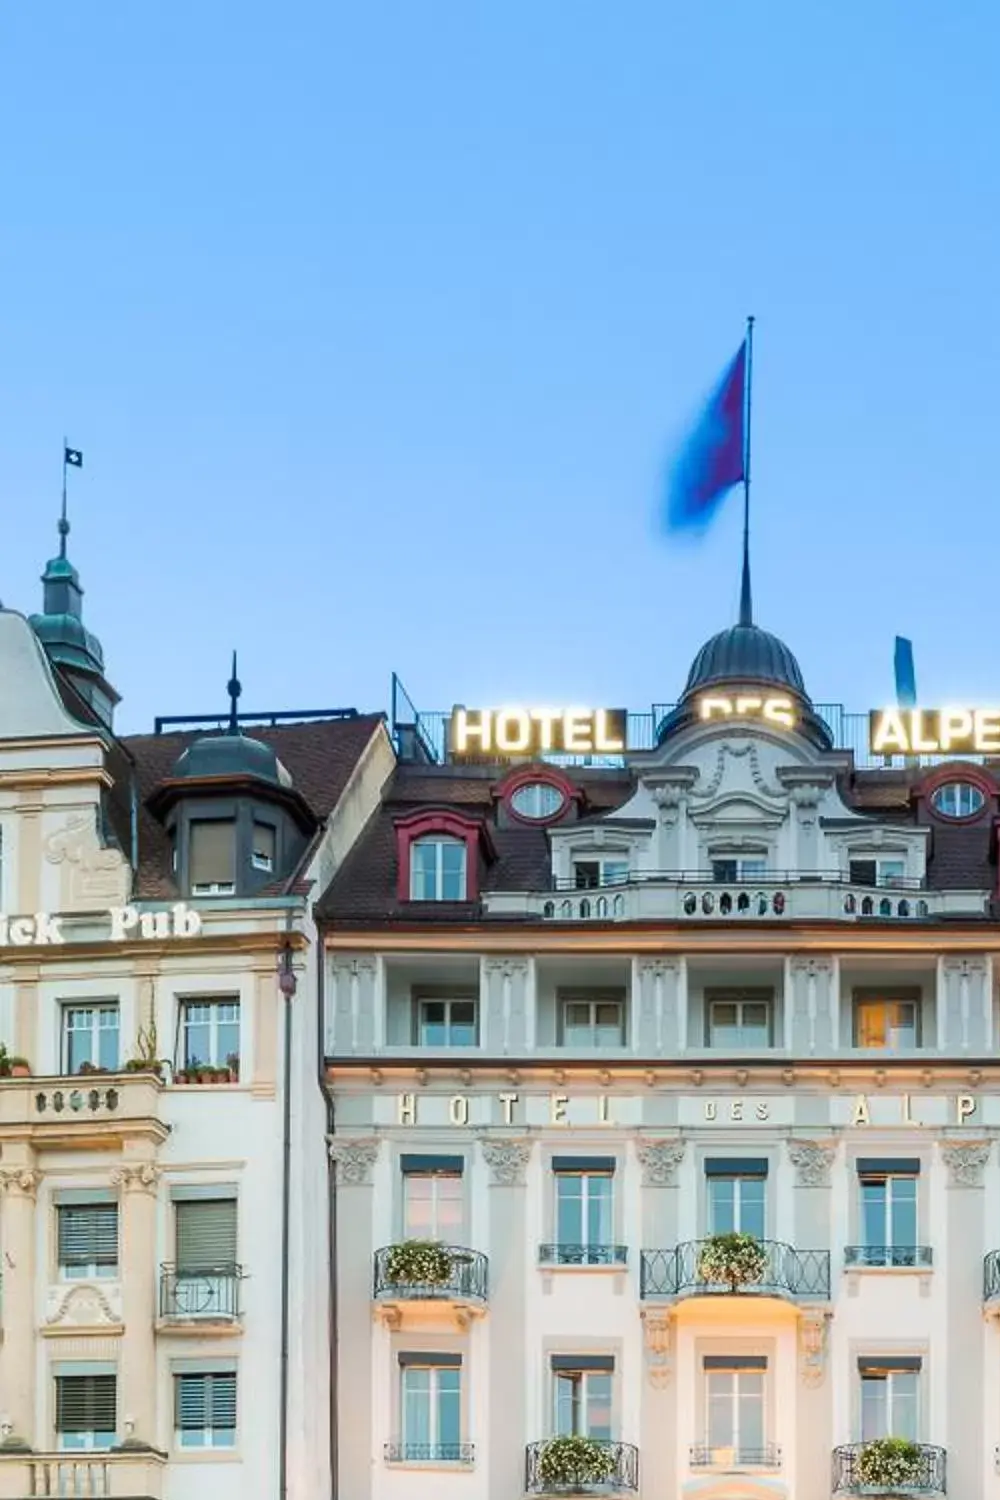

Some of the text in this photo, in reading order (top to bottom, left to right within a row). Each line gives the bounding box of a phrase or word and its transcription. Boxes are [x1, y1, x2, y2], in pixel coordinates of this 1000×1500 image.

[455, 706, 623, 751] HOTEL
[109, 903, 201, 941] Pub
[398, 1093, 615, 1125] HOTEL
[704, 1101, 769, 1120] DES
